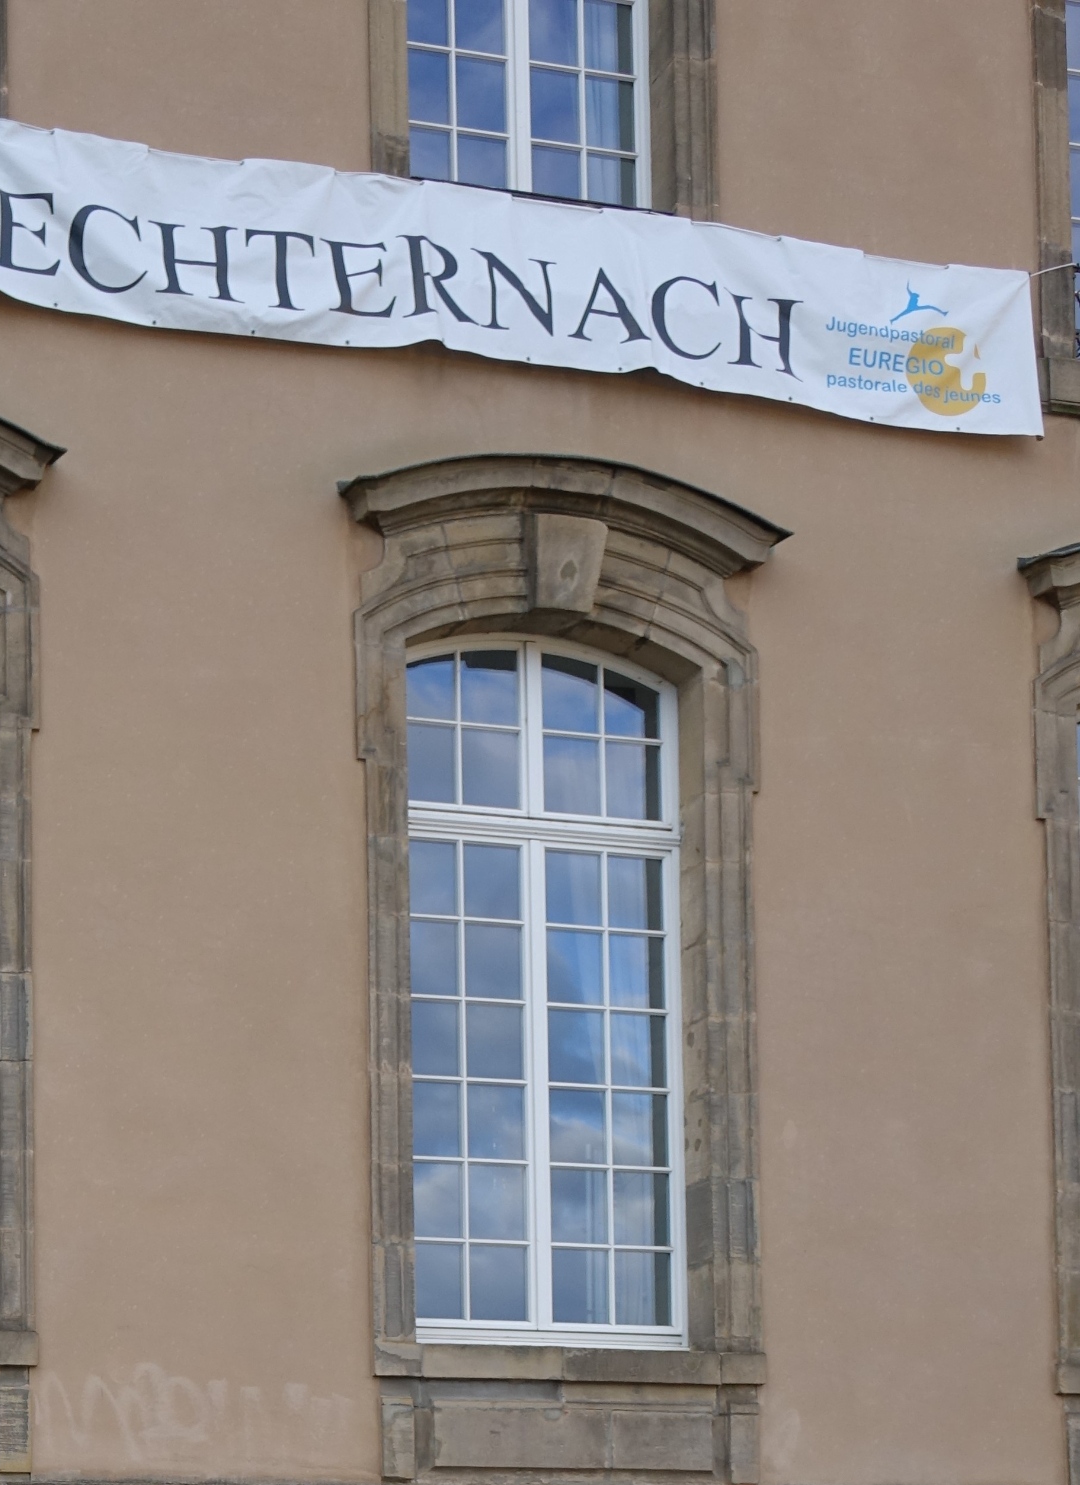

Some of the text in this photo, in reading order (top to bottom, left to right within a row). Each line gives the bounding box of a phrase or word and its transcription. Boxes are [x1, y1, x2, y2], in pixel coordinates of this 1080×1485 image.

[826, 316, 955, 349] Jugendpastoral
[848, 347, 944, 376] EUREGIO
[827, 374, 1001, 404] pastorale des jeunes
